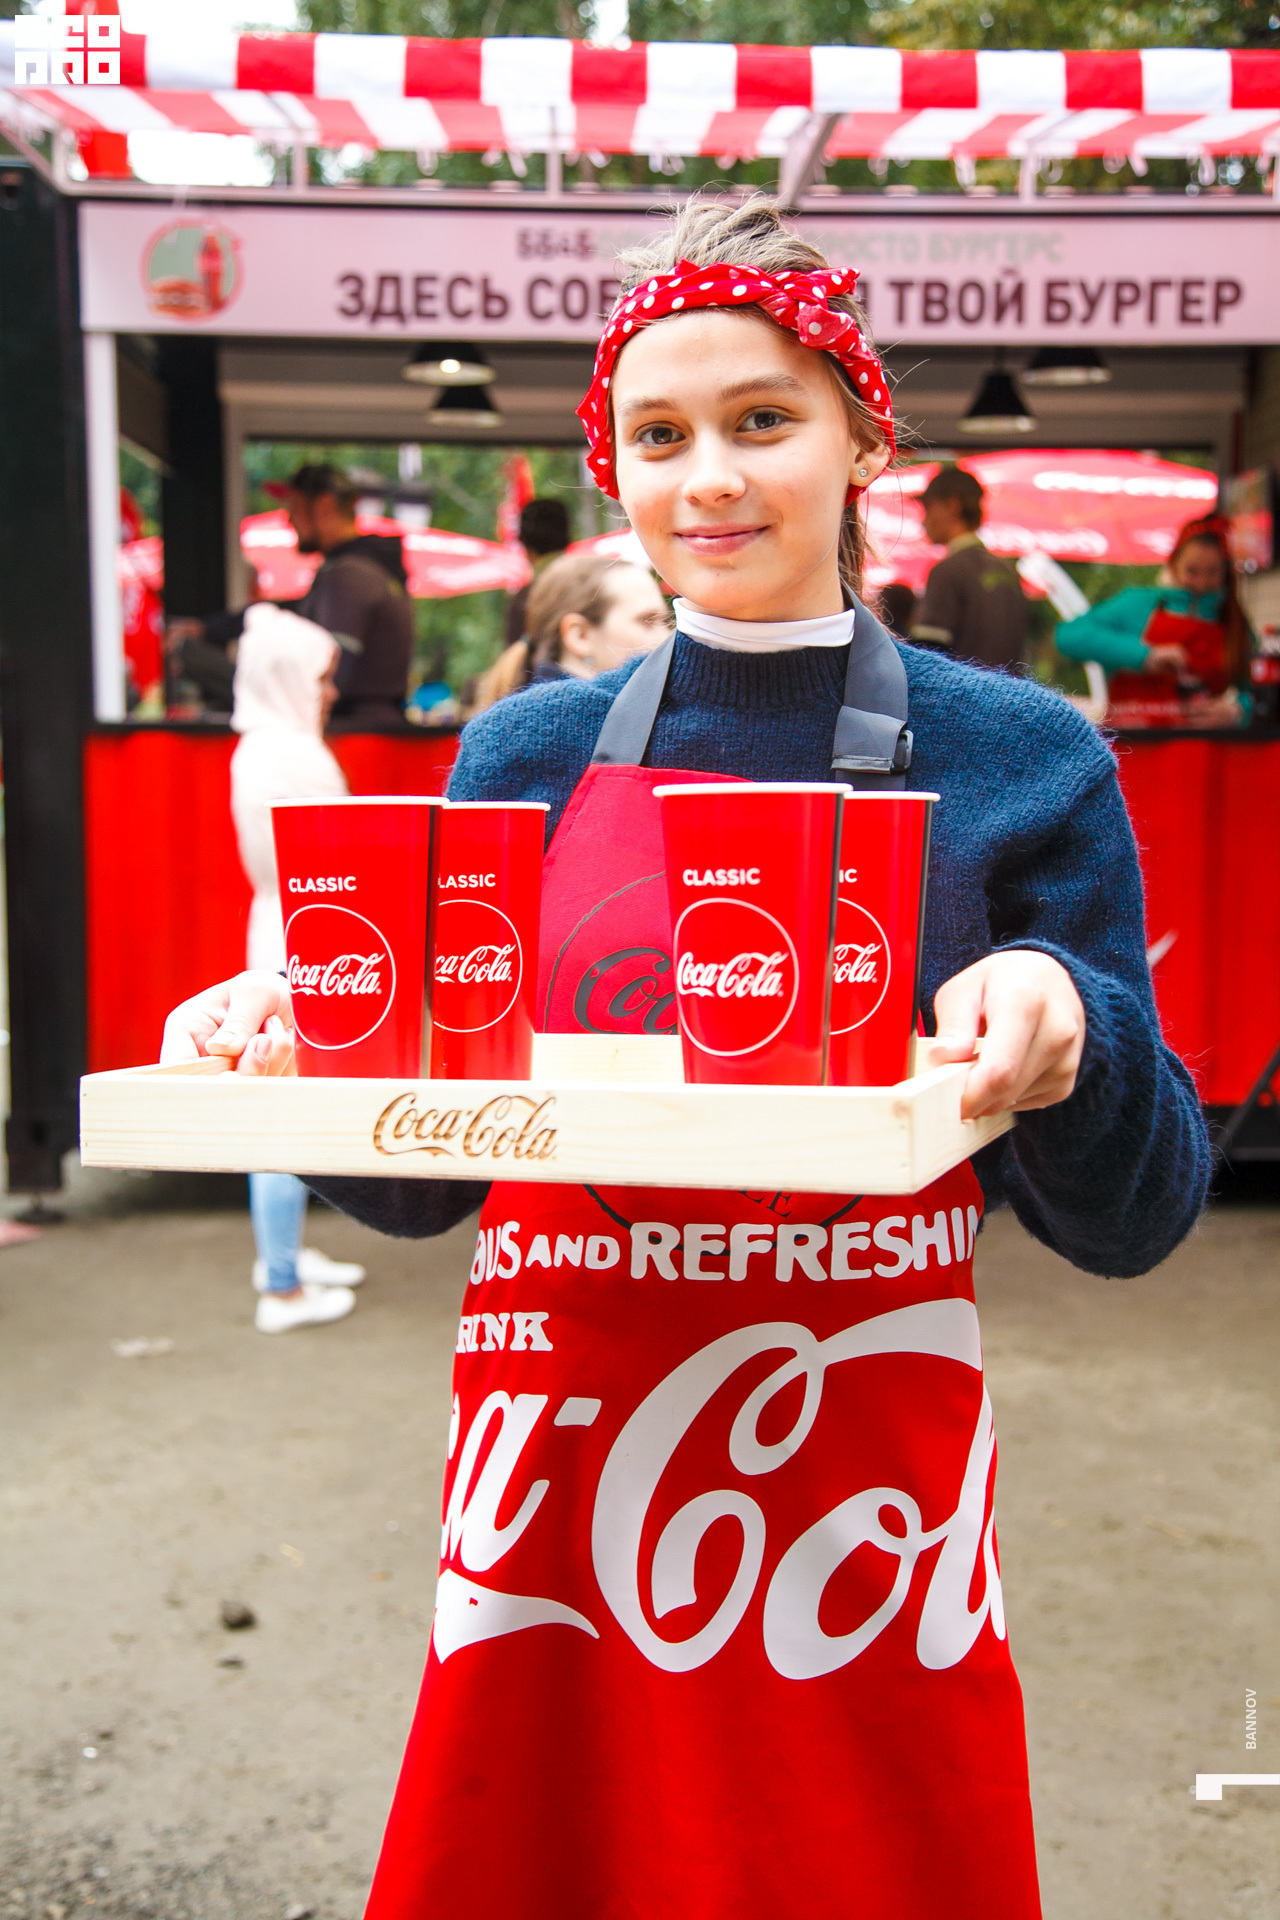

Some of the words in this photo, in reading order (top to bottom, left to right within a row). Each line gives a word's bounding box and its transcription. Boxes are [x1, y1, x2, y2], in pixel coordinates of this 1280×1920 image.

[336, 273, 509, 326] ЗДЕСЬ
[888, 267, 1025, 325] ТВОЙ
[1043, 279, 1243, 327] БУРГЕР
[288, 876, 357, 893] CLASSIC
[437, 873, 496, 889] LASSIC
[683, 867, 761, 887] CLASSIC
[288, 952, 386, 997] Coca-Cola
[434, 944, 516, 984] ca-Cola
[677, 951, 789, 998] Coca-Cola
[373, 1092, 558, 1160] Coca-Cola
[525, 1233, 621, 1270] AND
[455, 1311, 554, 1354] RINK
